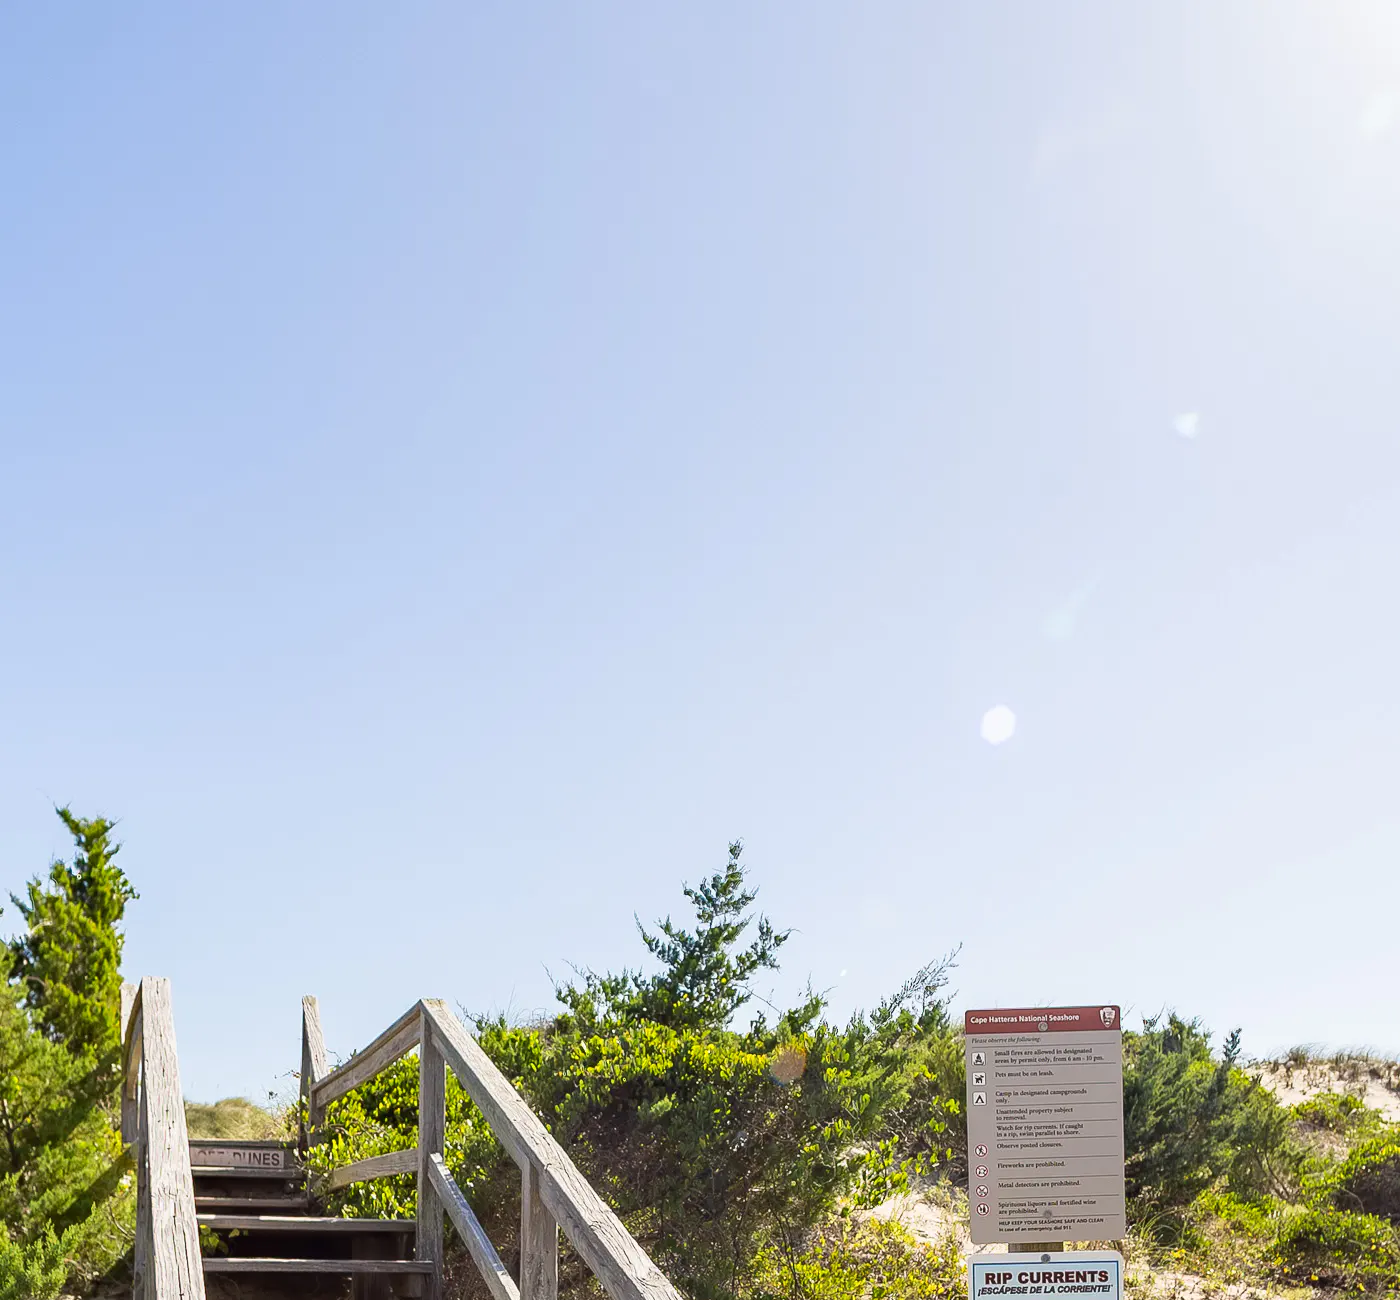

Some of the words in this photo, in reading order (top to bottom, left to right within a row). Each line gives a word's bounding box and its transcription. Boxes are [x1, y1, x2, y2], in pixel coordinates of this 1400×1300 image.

[970, 1016, 987, 1024] Cape
[989, 1015, 1018, 1023] Hatteras
[1019, 1014, 1048, 1022] National
[1049, 1014, 1079, 1022] Seashore
[1020, 1089, 1049, 1097] designated
[1050, 1088, 1087, 1096] campgrounds
[998, 1201, 1026, 1209] Spirituous
[1028, 1200, 1047, 1208] liquors
[985, 1272, 1013, 1285] RIP
[1018, 1270, 1109, 1284] CURRENTS
[978, 1284, 1028, 1297] ¡ESCÁPESE
[1029, 1286, 1042, 1294] DE
[1044, 1285, 1055, 1293] LA
[1059, 1285, 1111, 1294] CORRIENTE!
